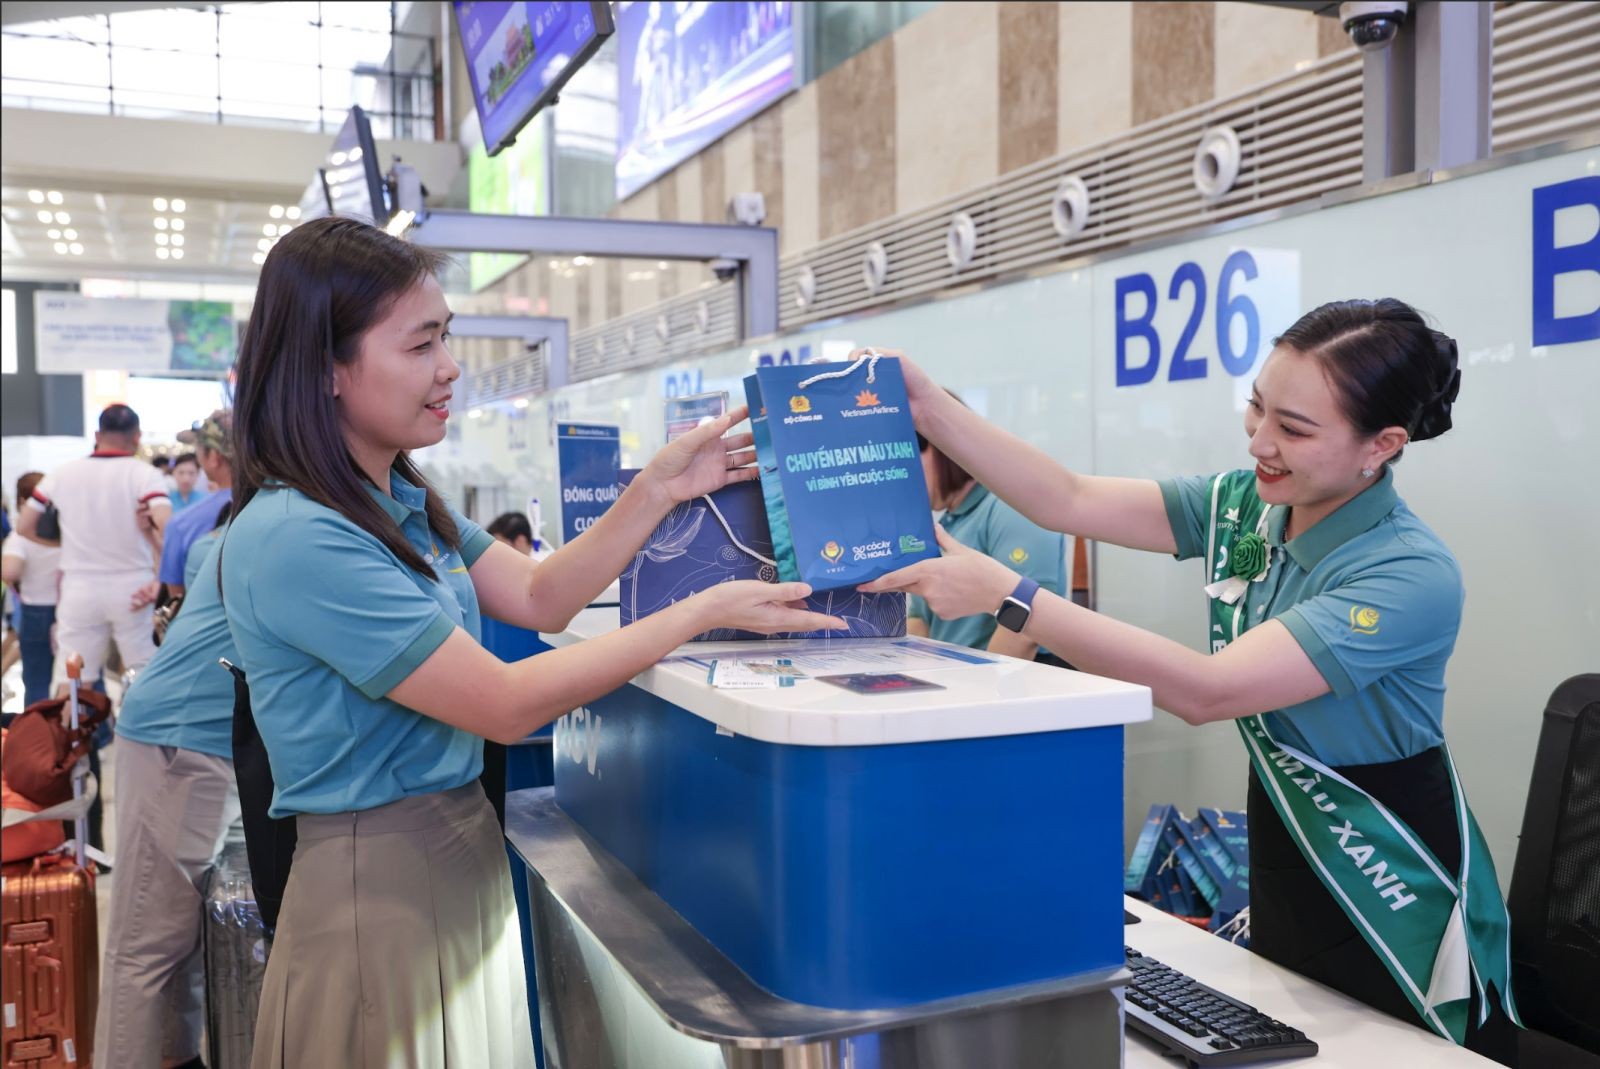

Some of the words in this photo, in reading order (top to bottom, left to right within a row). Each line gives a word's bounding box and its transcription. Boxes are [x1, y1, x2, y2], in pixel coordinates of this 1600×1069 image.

[1115, 249, 1261, 387] B26
[813, 413, 823, 421] AN
[840, 408, 873, 418] Vietnam
[873, 405, 900, 415] Airlines
[785, 445, 836, 472] CHUYẾN
[835, 446, 859, 466] BAY
[858, 440, 886, 463] MÀU
[884, 441, 915, 460] XANH
[819, 475, 840, 490] BÌNH
[839, 472, 859, 487] YÊN
[859, 468, 885, 485] CUỘC
[564, 486, 593, 503] ĐÓNG
[1269, 750, 1338, 813] MÀU
[1328, 819, 1418, 911] XANH
